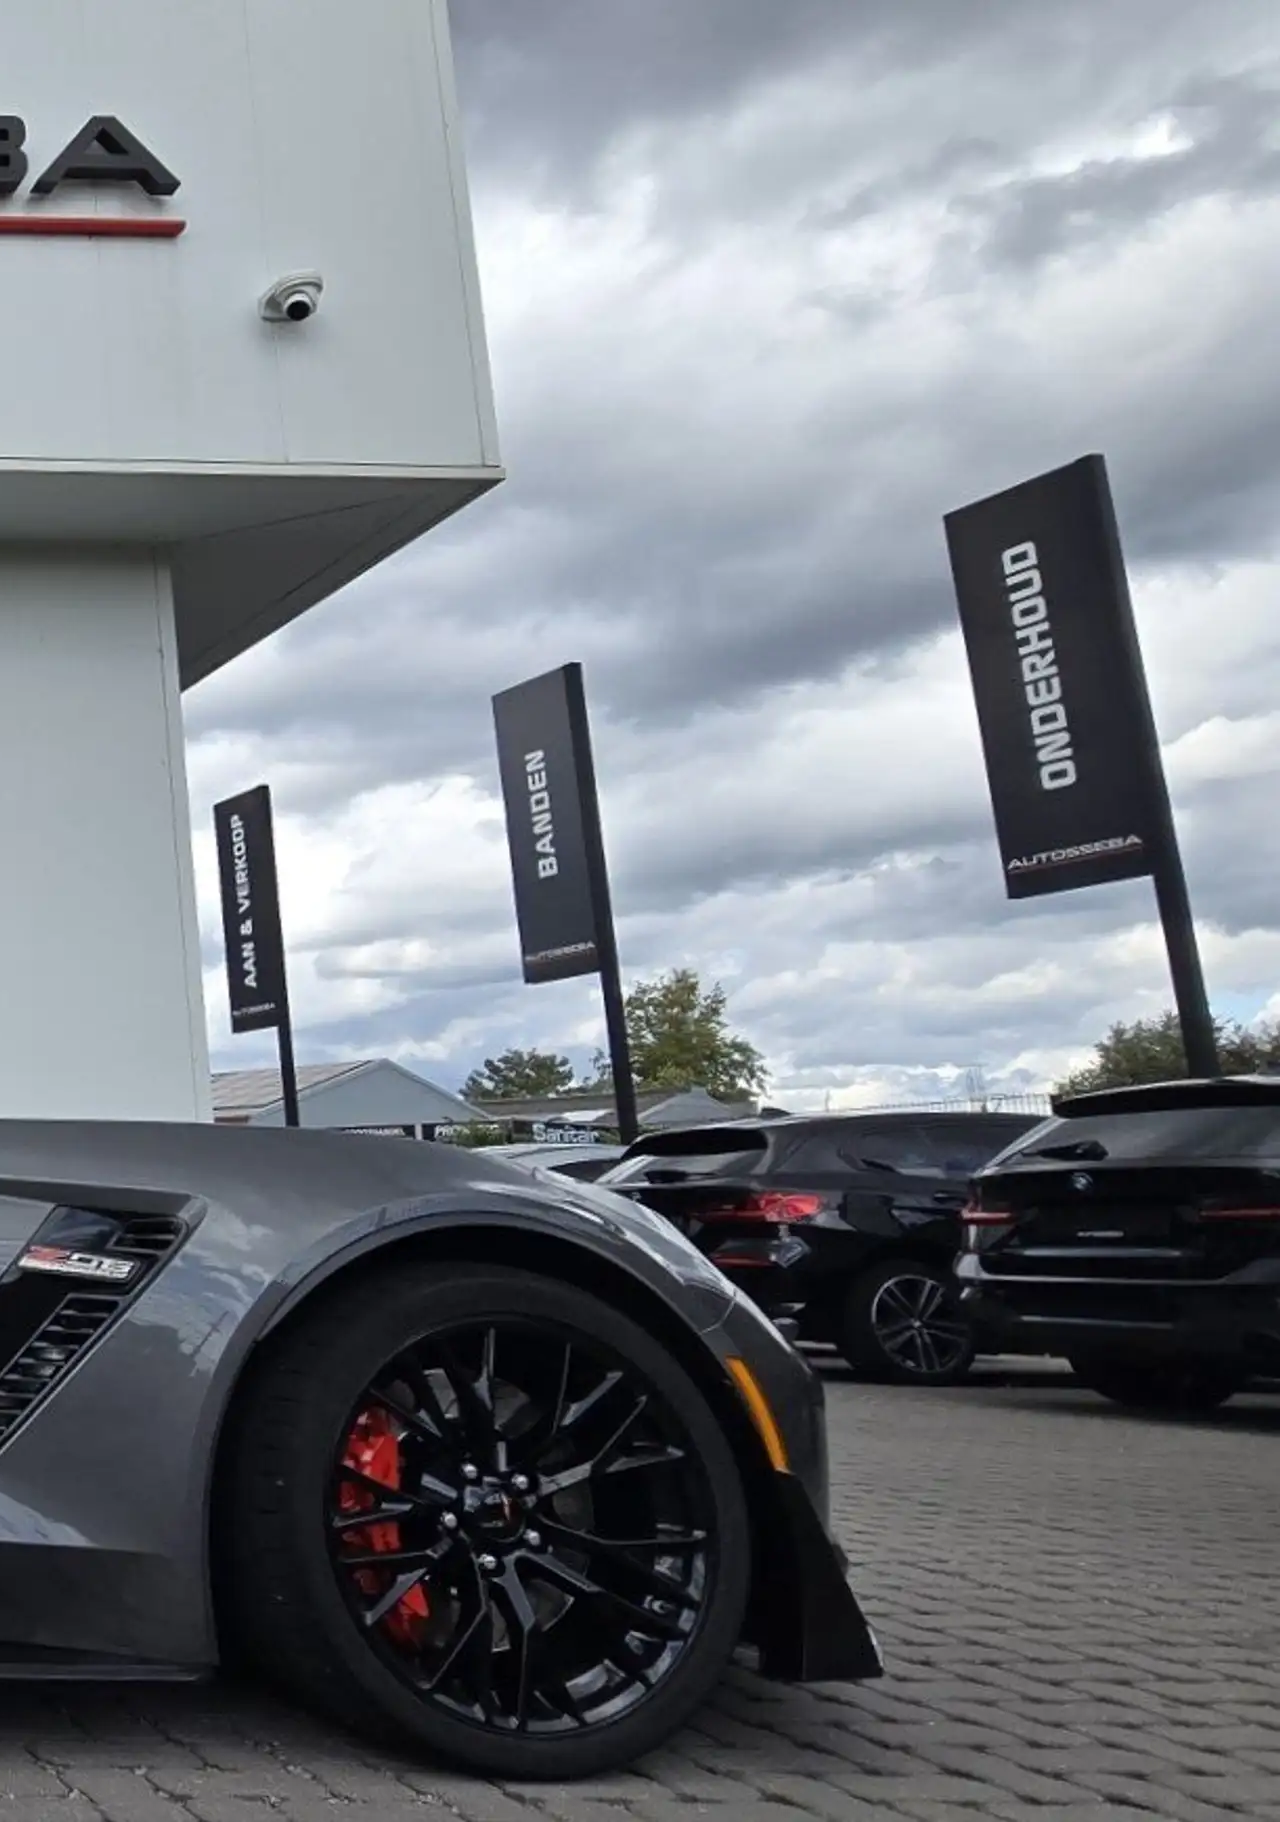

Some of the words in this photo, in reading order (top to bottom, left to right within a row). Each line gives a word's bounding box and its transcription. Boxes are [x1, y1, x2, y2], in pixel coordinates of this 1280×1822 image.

[1002, 540, 1077, 790] ONDERHOUD
[524, 749, 559, 879] BANDEN
[231, 814, 251, 914] VERKOOP
[1007, 834, 1143, 870] AUTOSSEBA
[240, 918, 253, 936] &
[242, 941, 258, 988] AAN
